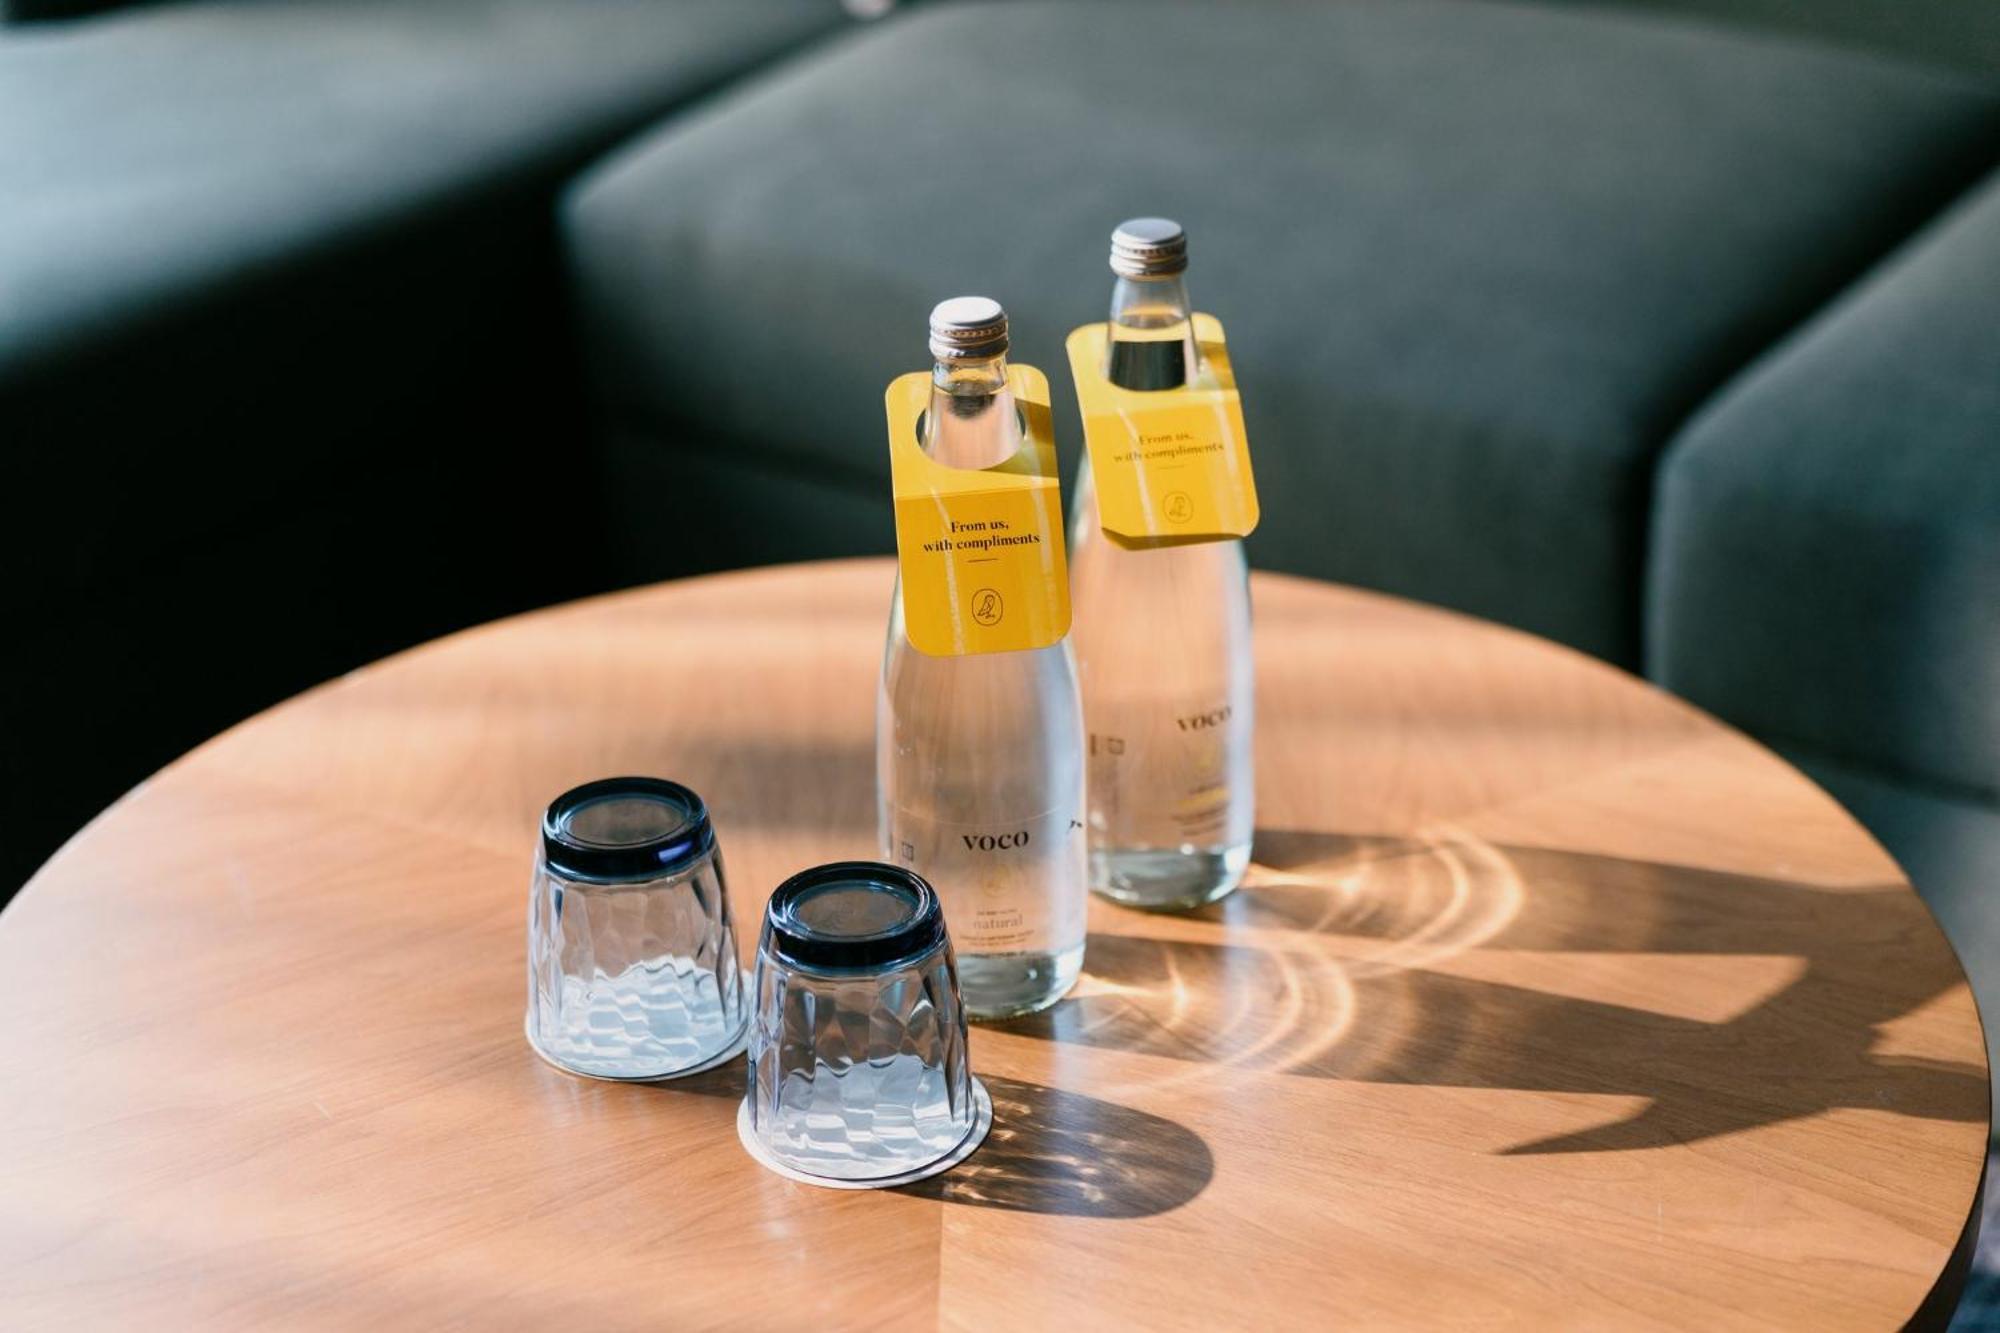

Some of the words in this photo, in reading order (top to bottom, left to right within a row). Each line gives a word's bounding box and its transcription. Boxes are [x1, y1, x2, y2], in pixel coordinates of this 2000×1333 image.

[1138, 434, 1173, 446] From
[1113, 451, 1142, 462] with
[1144, 443, 1224, 459] compliments
[951, 520, 986, 533] From
[990, 520, 1009, 531] us,
[923, 539, 953, 552] with
[956, 533, 1041, 550] compliments
[973, 914, 1023, 930] natural
